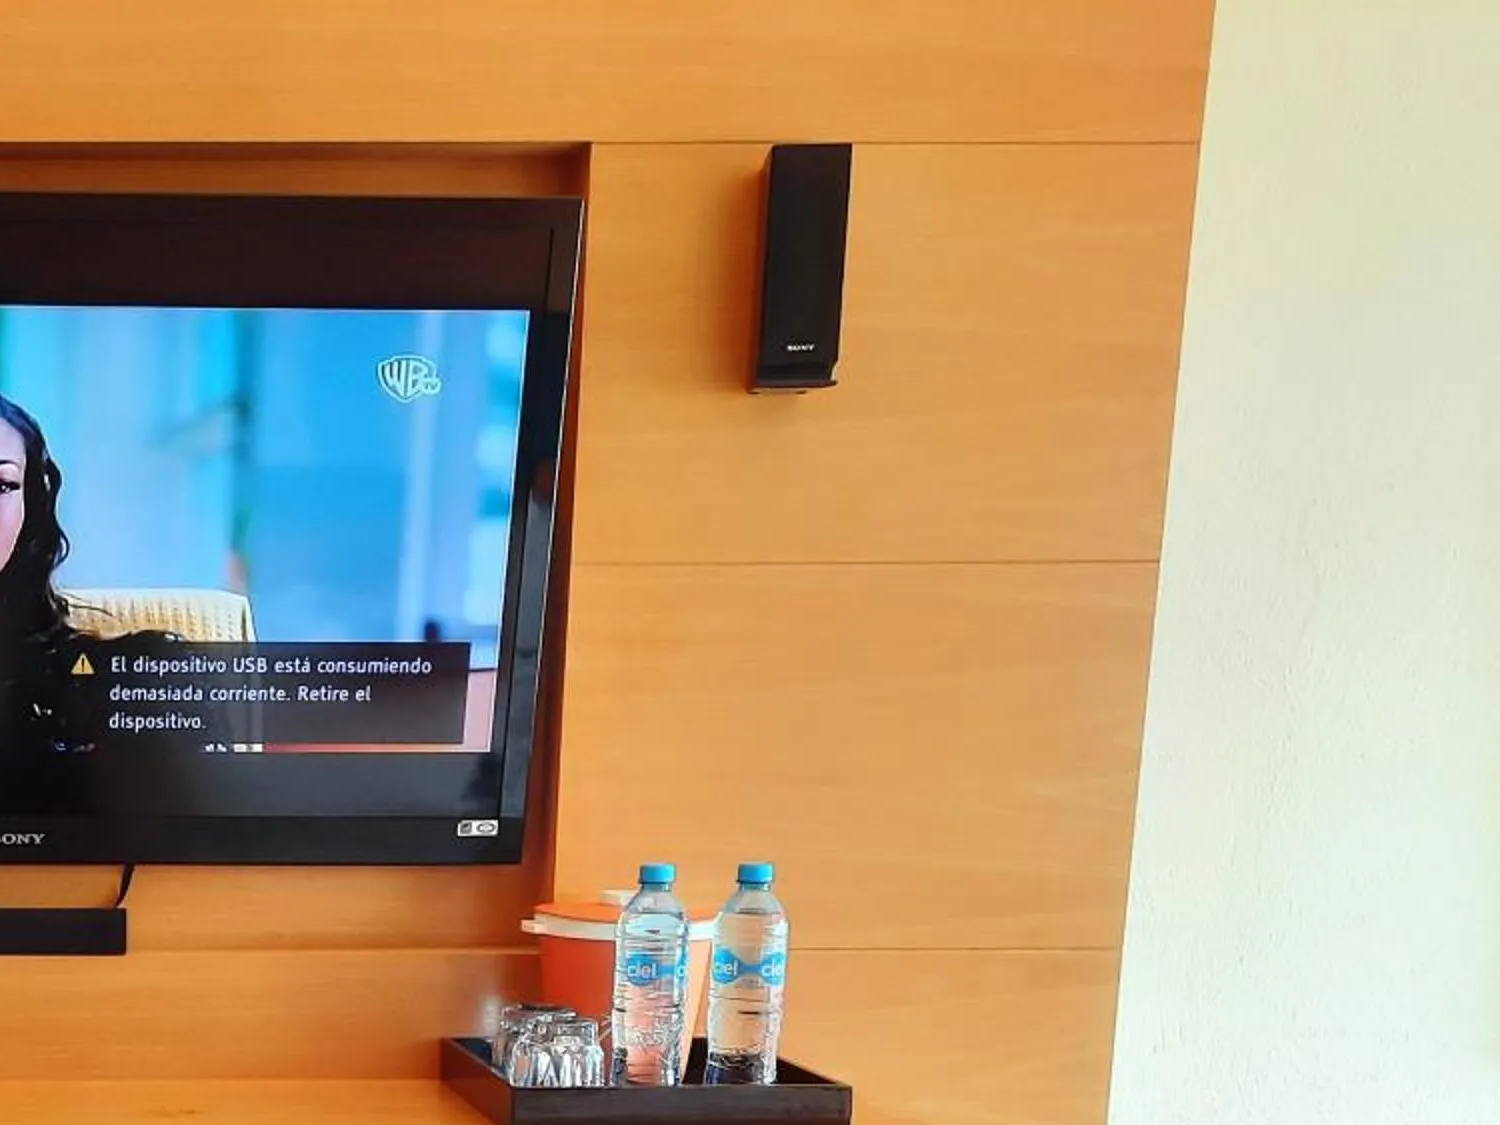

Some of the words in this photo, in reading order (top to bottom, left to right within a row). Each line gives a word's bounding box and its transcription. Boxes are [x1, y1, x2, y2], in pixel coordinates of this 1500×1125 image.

[111, 655, 127, 673] El
[133, 655, 227, 679] dispositivo
[233, 657, 268, 673] USB
[274, 656, 311, 673] está
[317, 656, 432, 674] consumiendo
[109, 684, 203, 701] demasiada
[210, 684, 291, 701] corriente.
[297, 685, 349, 702] Retire
[355, 685, 372, 702] el
[109, 711, 207, 734] dispositivo.
